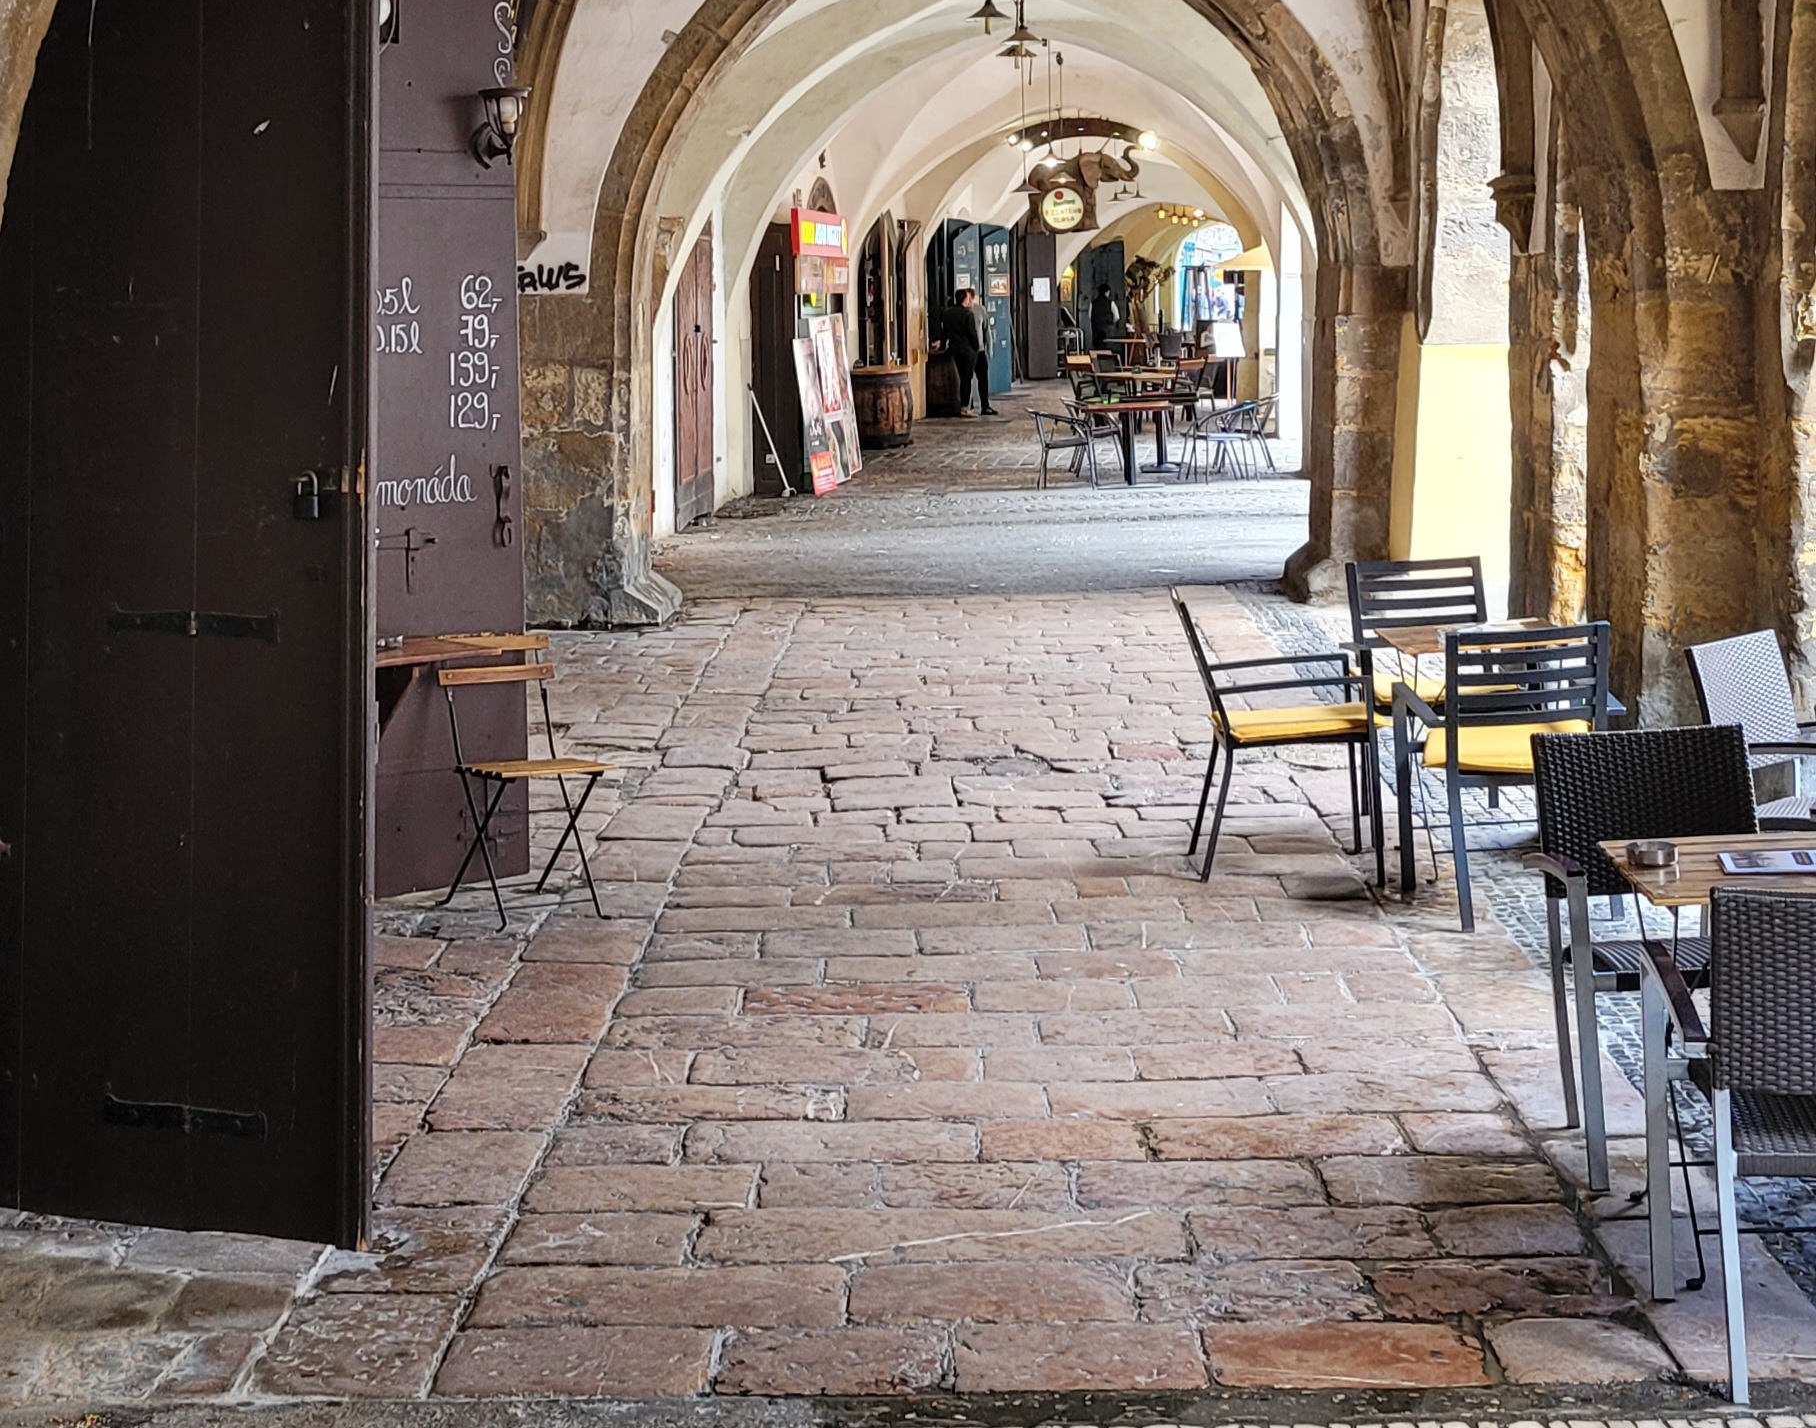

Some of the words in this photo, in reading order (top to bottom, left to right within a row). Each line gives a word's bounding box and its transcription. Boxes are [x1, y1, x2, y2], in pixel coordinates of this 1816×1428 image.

[460, 274, 503, 313] 62,-
[459, 313, 500, 349] 79,-
[450, 350, 501, 389] 139,-
[450, 391, 501, 432] 129,-
